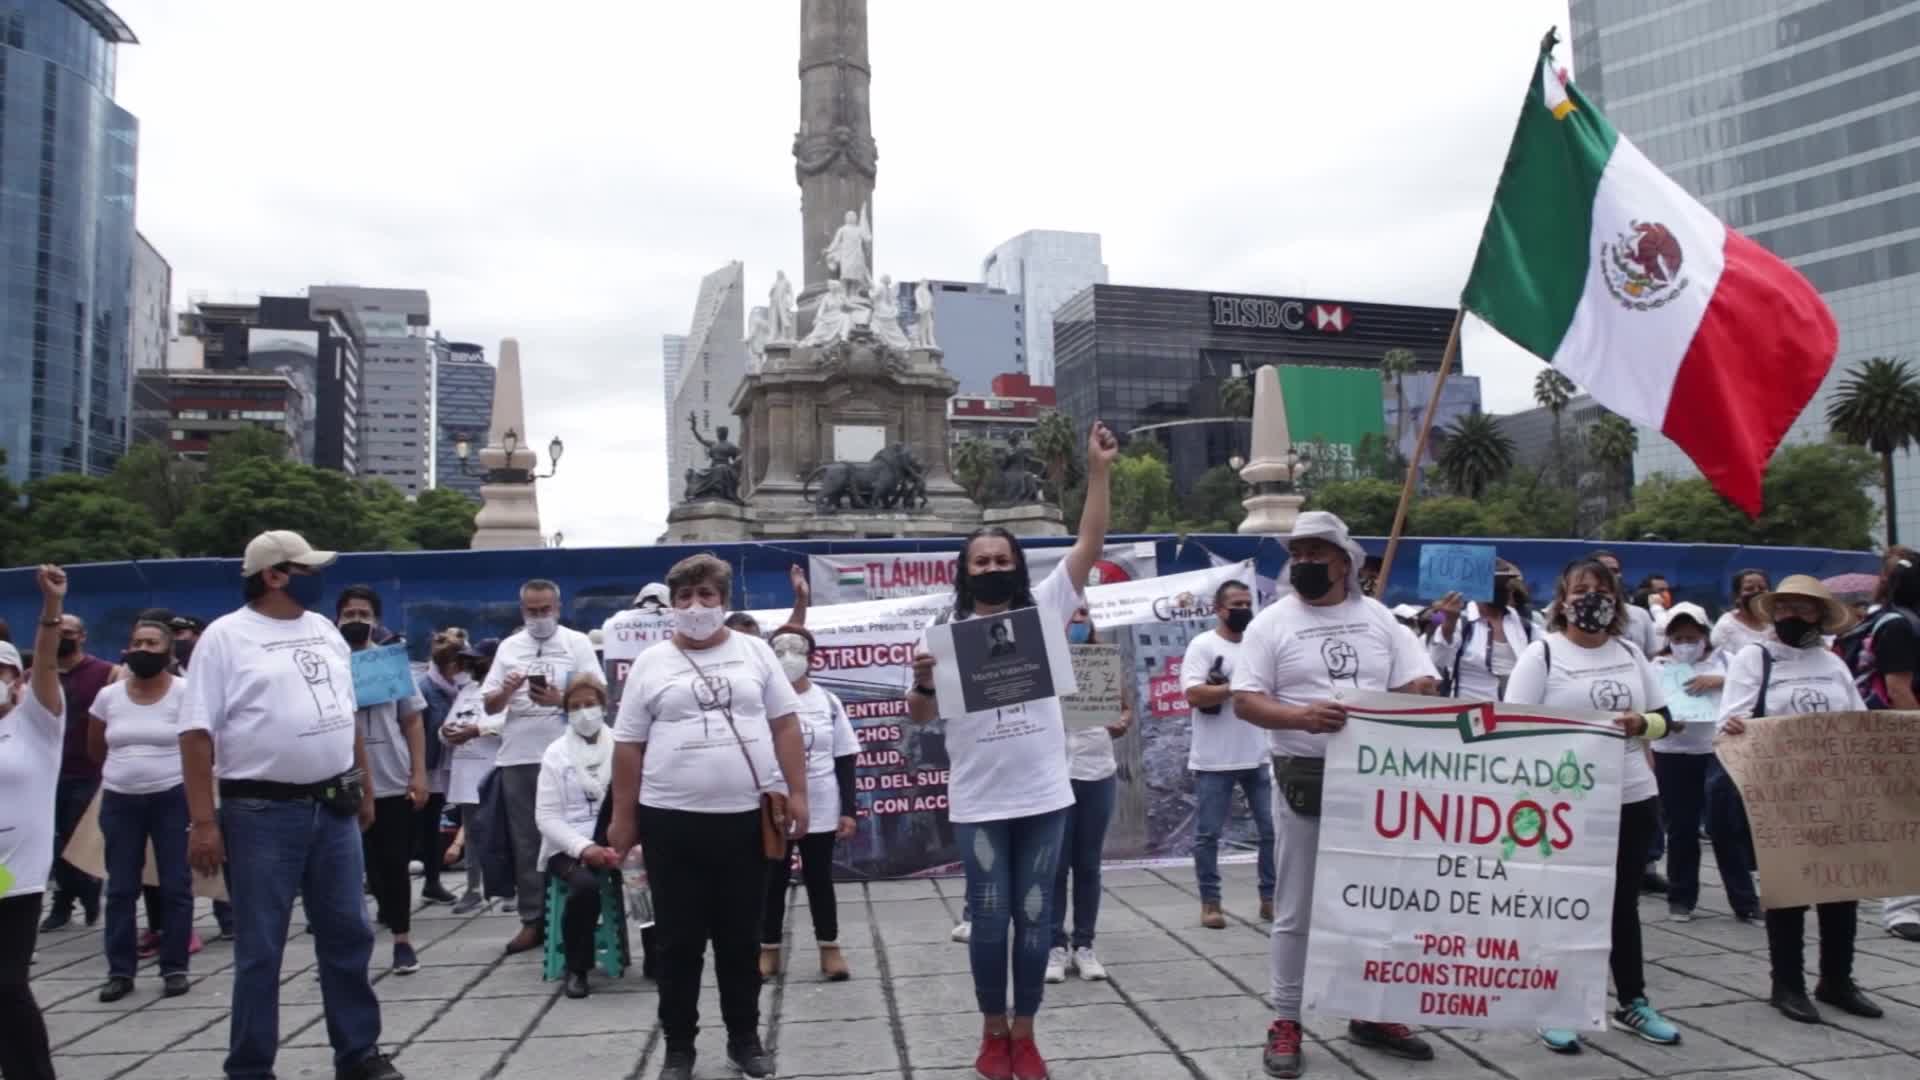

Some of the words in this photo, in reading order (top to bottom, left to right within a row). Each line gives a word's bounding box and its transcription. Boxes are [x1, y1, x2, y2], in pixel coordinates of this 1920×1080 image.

[1213, 296, 1304, 329] HSBC
[1152, 596, 1217, 622] CHIHUA
[617, 630, 673, 642] UNID
[855, 726, 901, 743] CHOS
[855, 752, 905, 766] ALUD,
[1357, 745, 1596, 791] DAMNIFICADOS
[881, 774, 913, 789] DEL
[918, 770, 950, 786] SUE
[874, 799, 909, 813] CON
[914, 795, 947, 810] ACC
[1374, 789, 1574, 850] UNIDOS
[1437, 854, 1467, 878] DE
[1476, 857, 1509, 881] LA
[1342, 883, 1440, 913] CIUDAD
[1450, 891, 1481, 916] DE
[1491, 889, 1590, 921] MÉXICO
[1476, 936, 1519, 962] UNA
[1363, 960, 1559, 991] RECONSTRUCCIÓN
[1420, 992, 1501, 1018] DIGNA"
